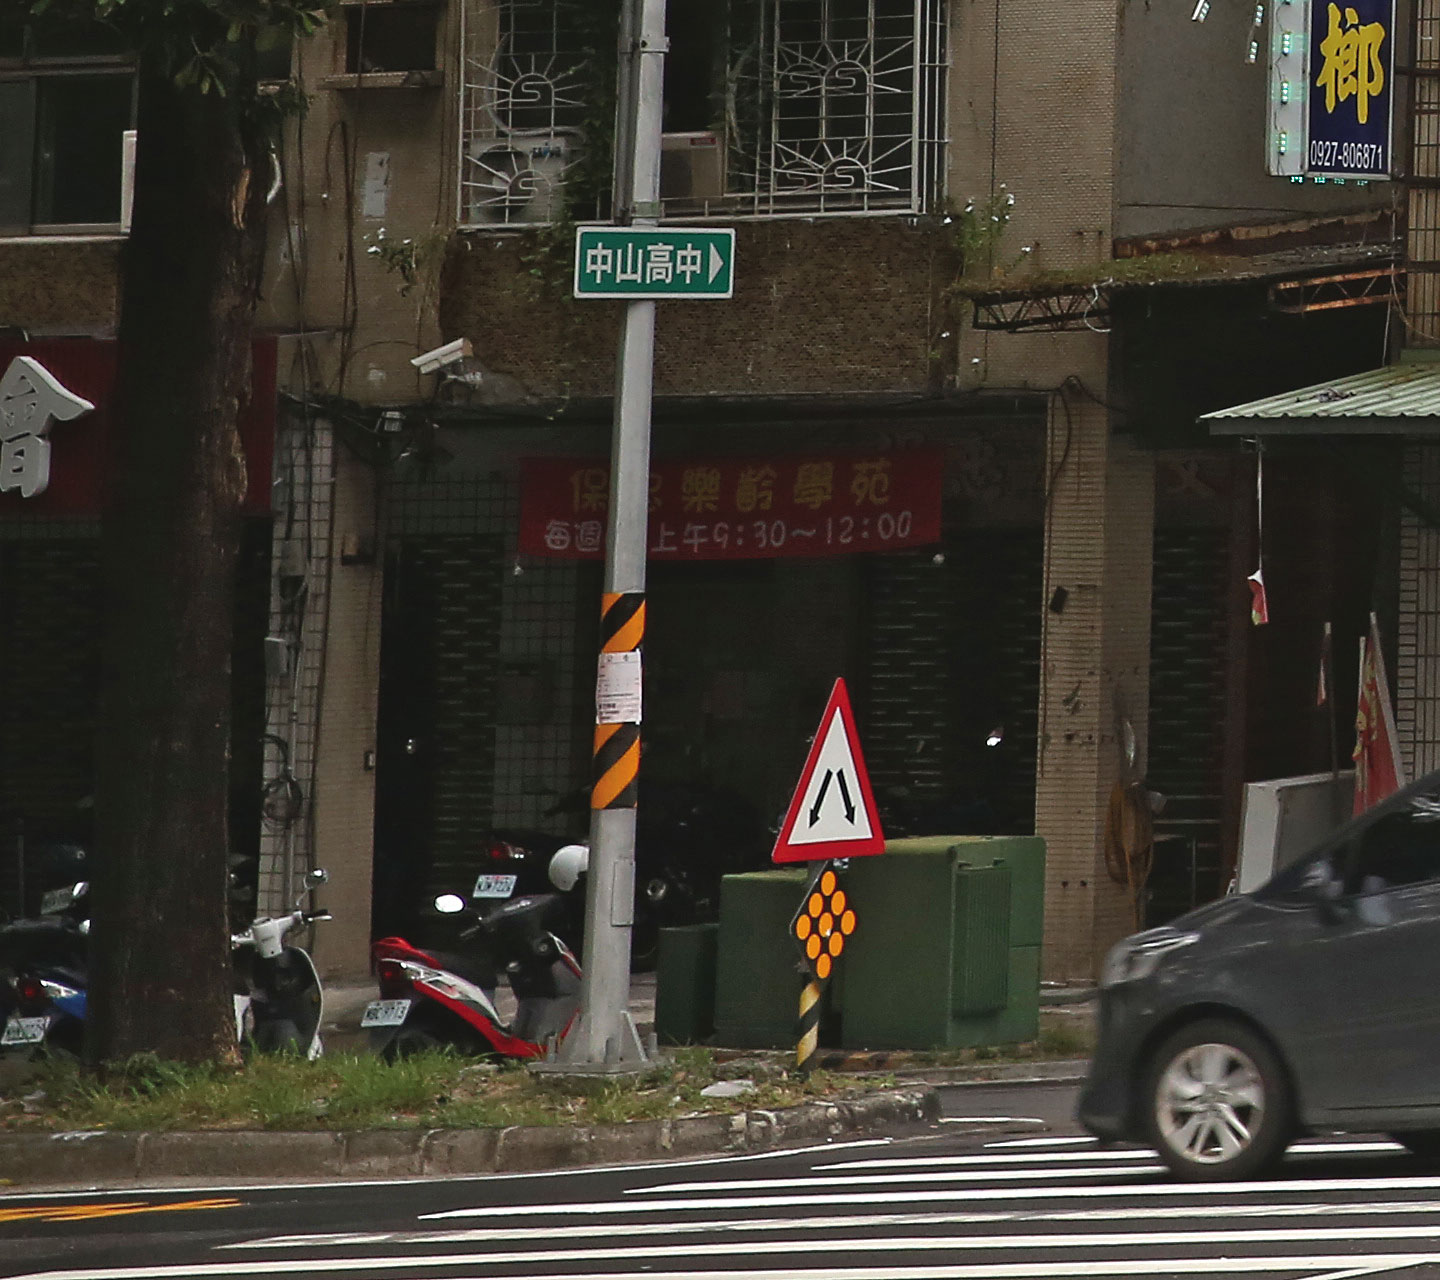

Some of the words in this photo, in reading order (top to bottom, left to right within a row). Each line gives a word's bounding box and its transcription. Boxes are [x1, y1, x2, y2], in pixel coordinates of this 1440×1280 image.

[1309, 139, 1385, 171] 0927-806871
[584, 242, 704, 286] 中山高中
